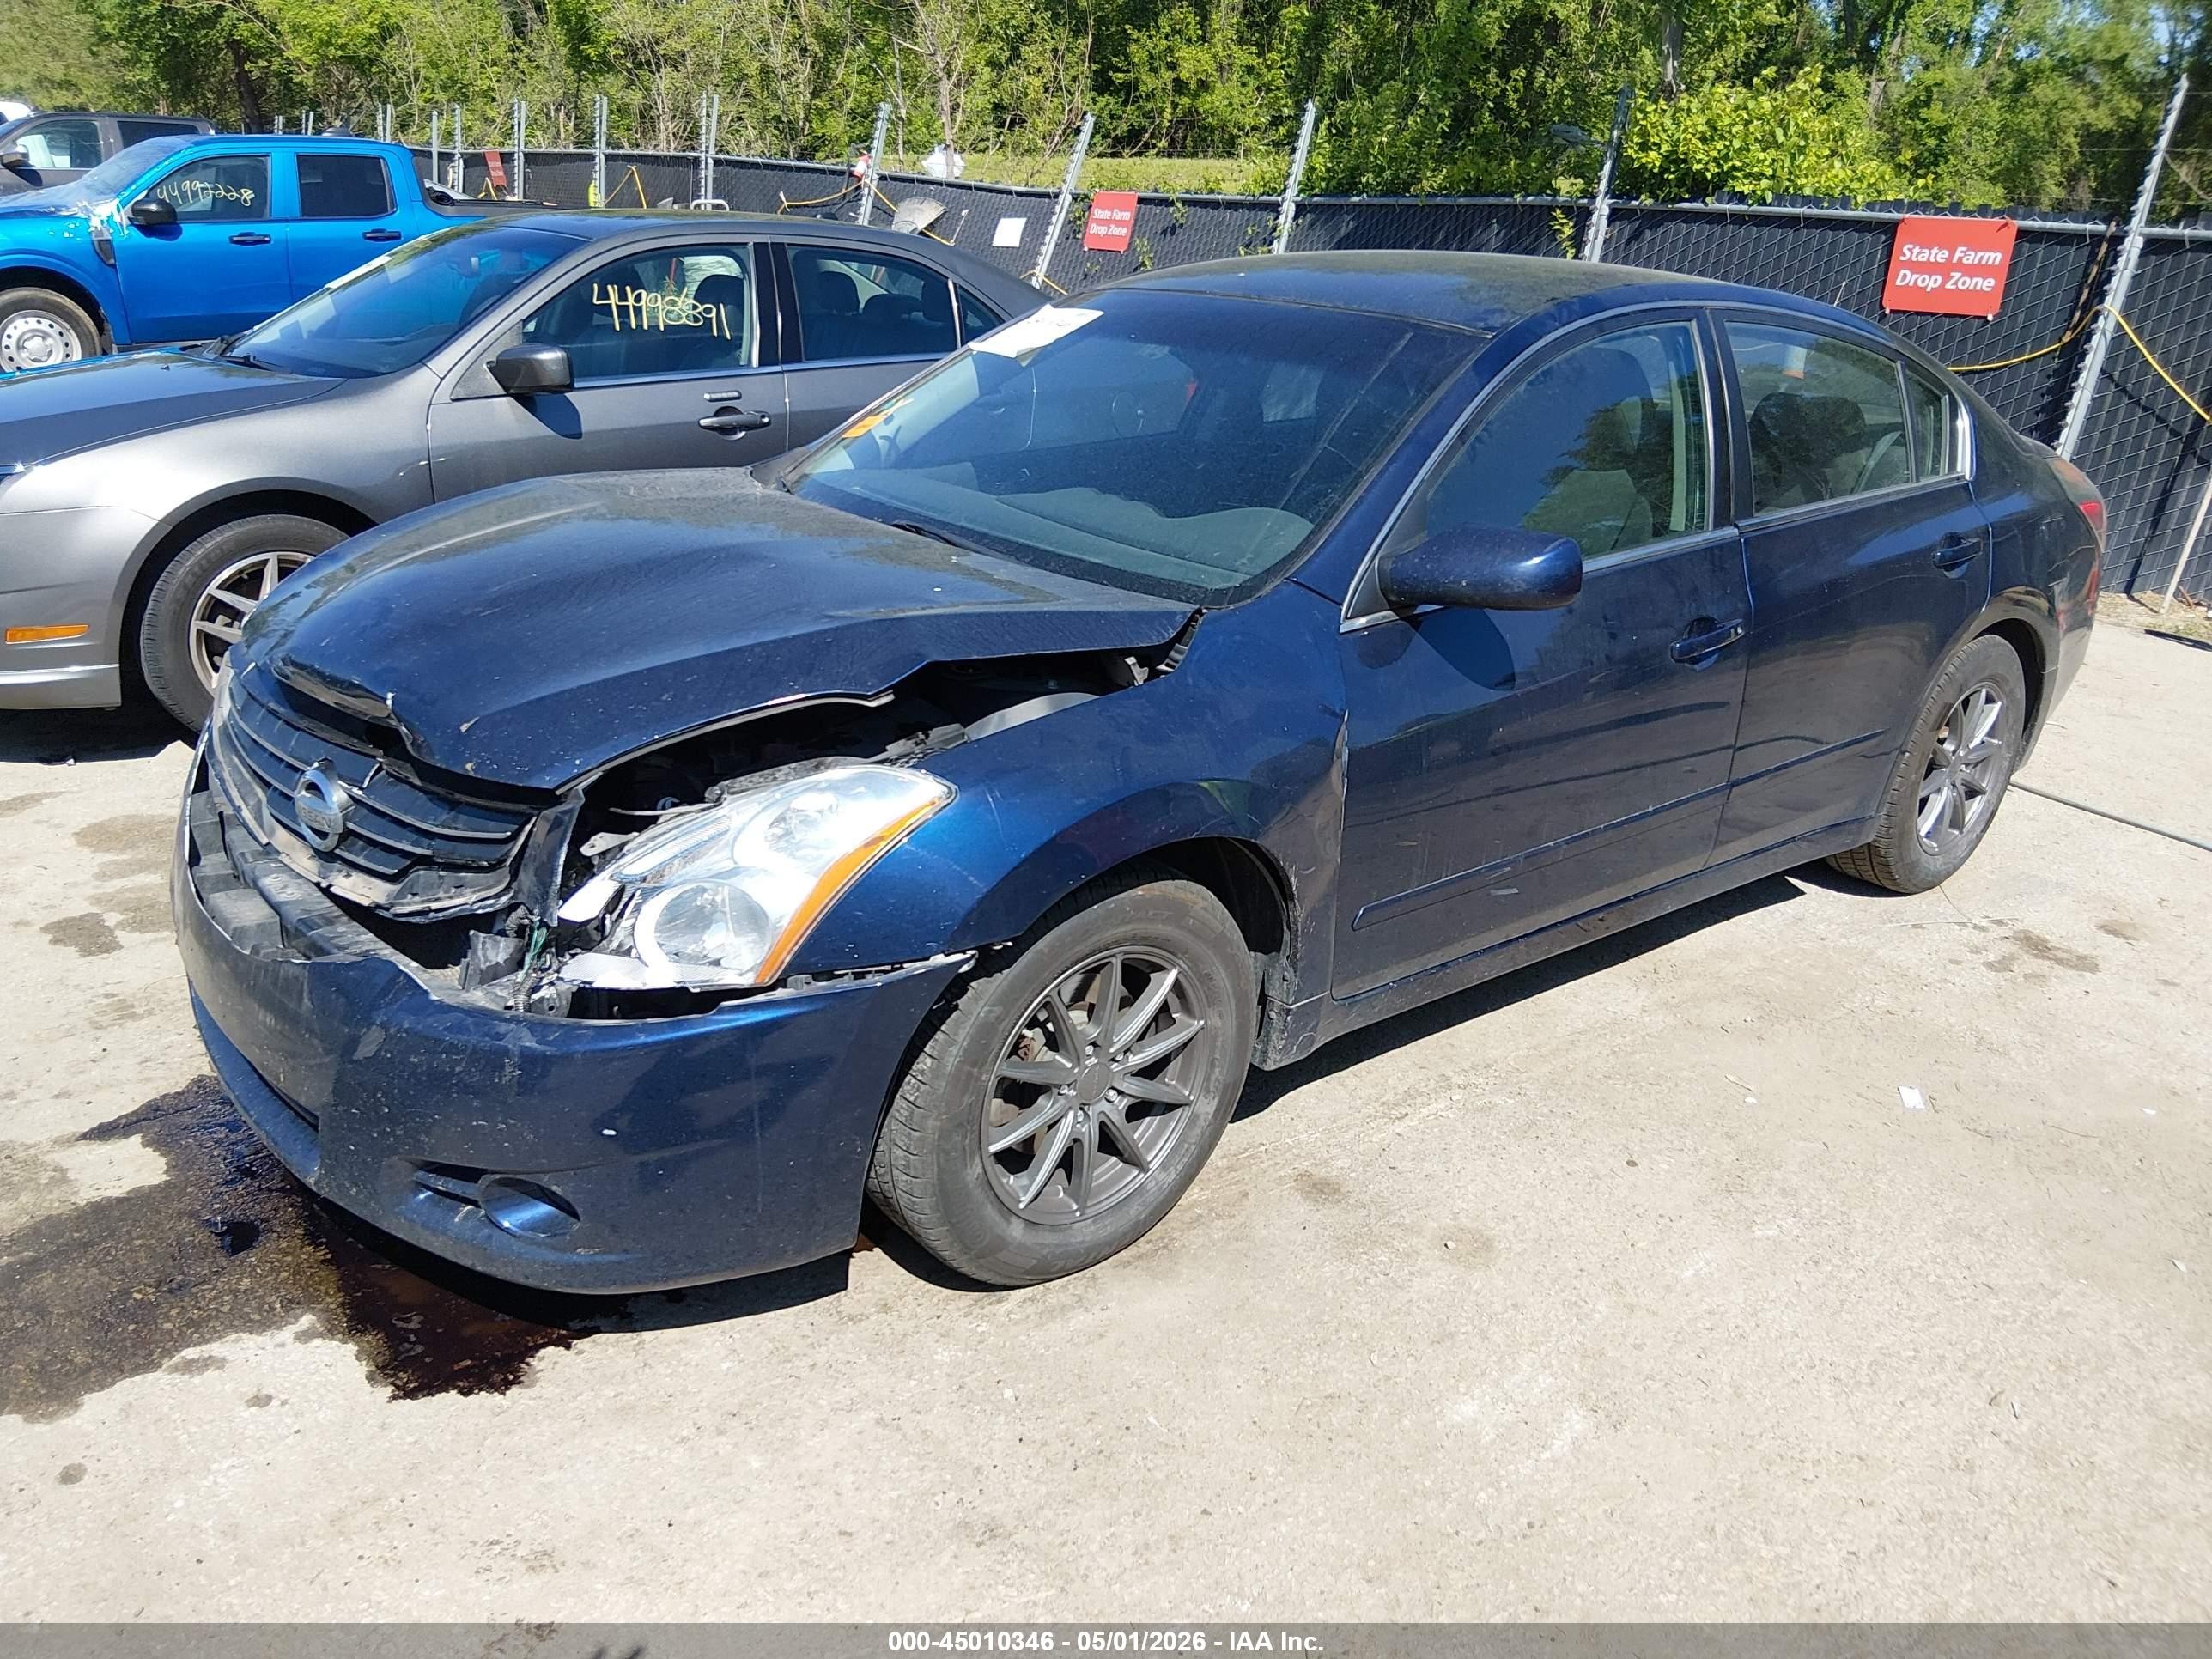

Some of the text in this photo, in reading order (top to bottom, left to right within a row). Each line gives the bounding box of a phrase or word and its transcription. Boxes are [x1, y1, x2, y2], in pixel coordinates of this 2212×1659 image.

[157, 180, 255, 206] 44992228
[1092, 208, 1131, 221] State Farm
[1089, 223, 1127, 237] Drop Zone
[1899, 244, 2002, 265] State Farm
[1895, 269, 1996, 292] Drop Zone
[592, 283, 731, 340] 44998891
